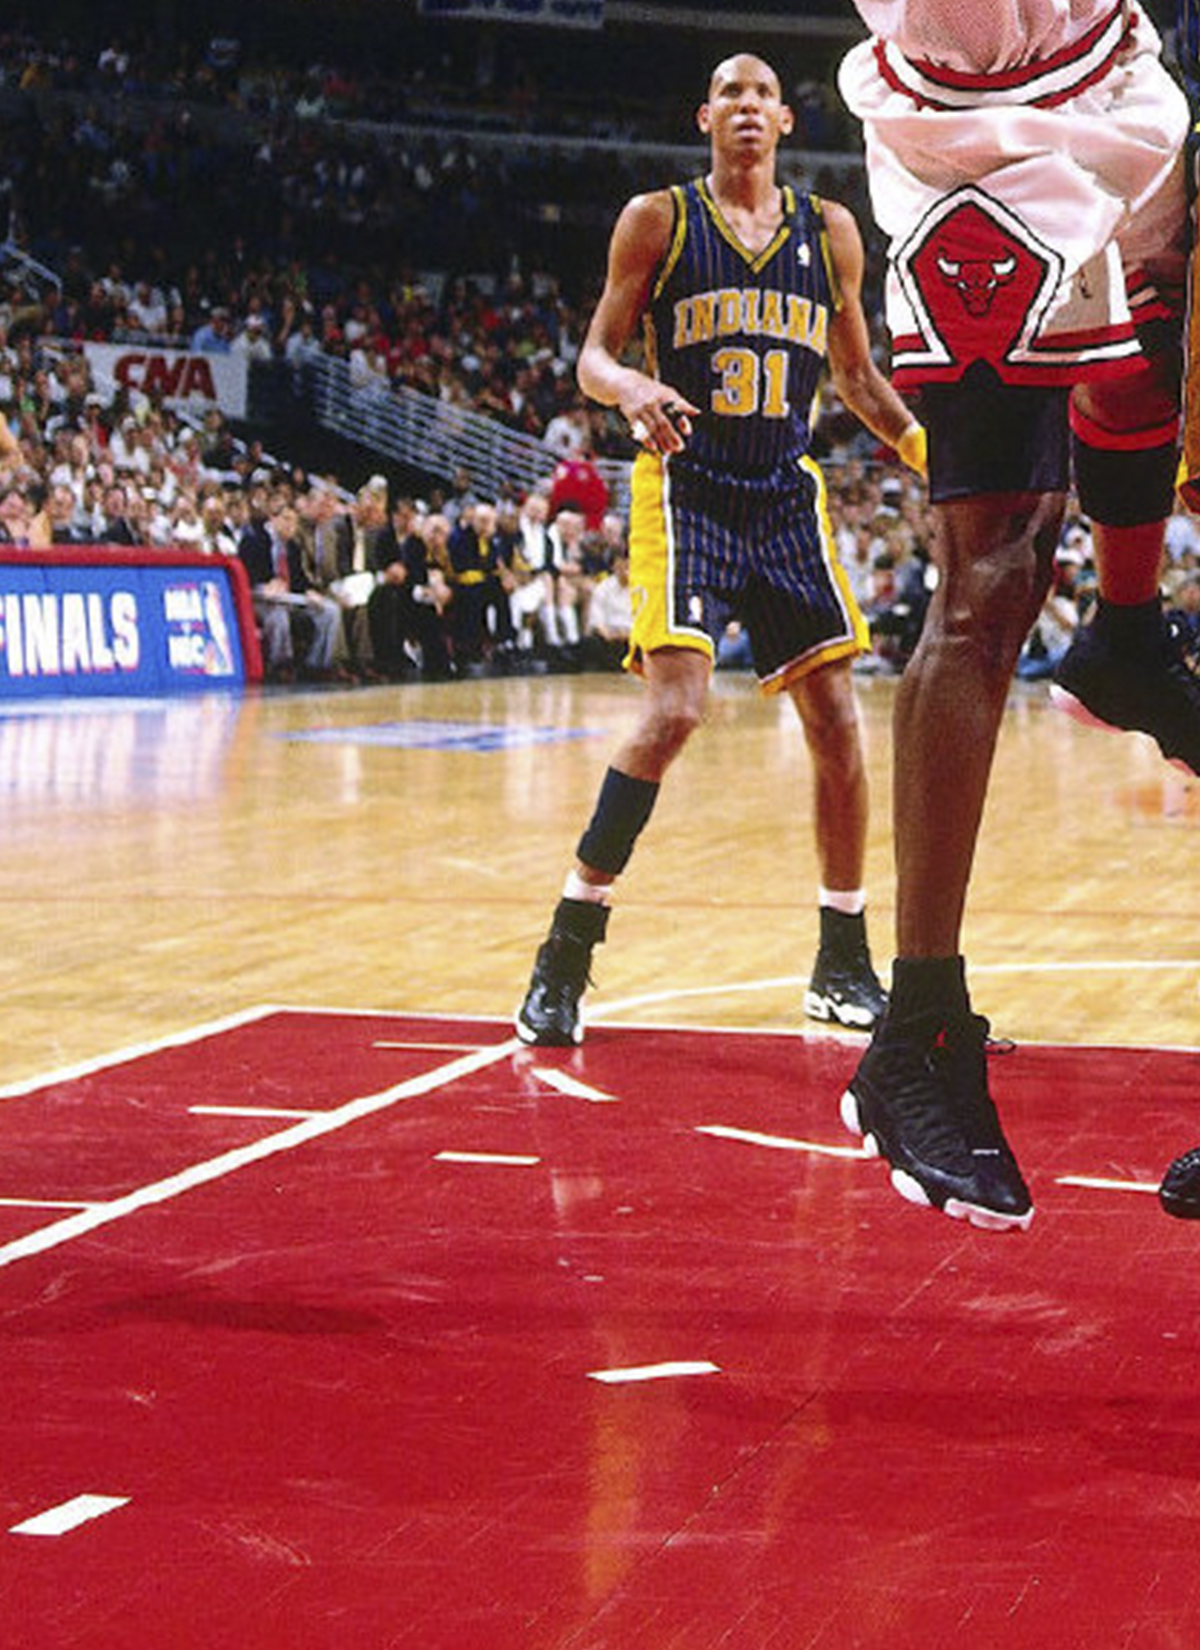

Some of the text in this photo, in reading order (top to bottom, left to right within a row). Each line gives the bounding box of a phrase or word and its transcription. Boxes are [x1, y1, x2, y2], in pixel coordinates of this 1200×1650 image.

[673, 288, 828, 357] INDIANA
[114, 354, 217, 400] CNA
[711, 347, 789, 419] 31
[0, 590, 140, 676] INALS
